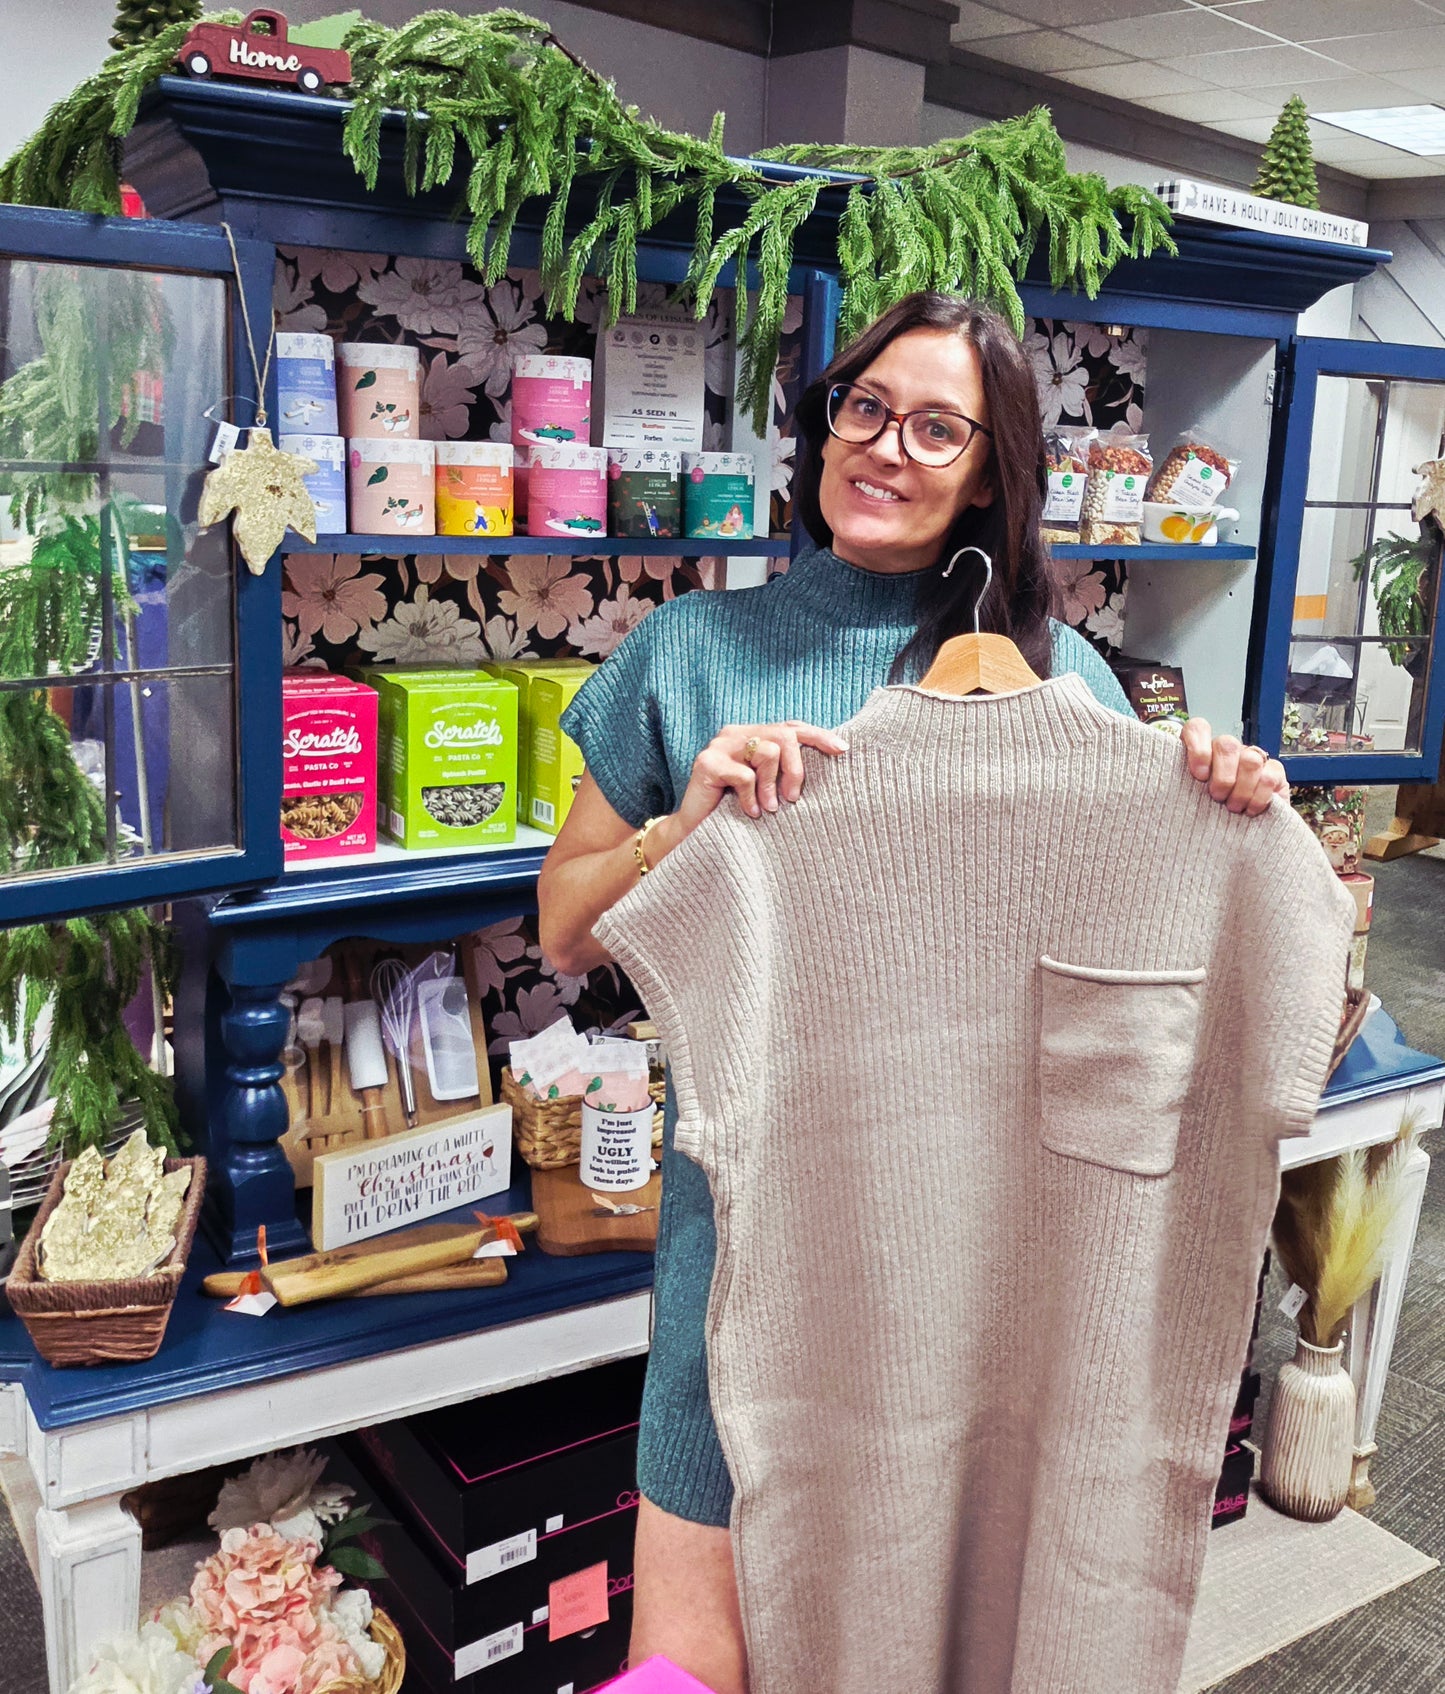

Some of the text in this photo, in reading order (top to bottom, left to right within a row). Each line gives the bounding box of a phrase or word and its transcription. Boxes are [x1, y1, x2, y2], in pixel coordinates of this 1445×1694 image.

[230, 38, 302, 71] Home
[1202, 194, 1349, 240] HAVE A HOLLY JOLLY CHRISTMAS
[1147, 703, 1174, 712] DIP MIX
[283, 725, 362, 758] Scratch
[424, 718, 503, 748] Scratch
[304, 762, 339, 771] PASTA Co
[597, 1126, 636, 1135] impressed
[602, 1136, 611, 1144] by
[348, 1128, 485, 1180] I'M DREAMING OF A WHITE
[598, 1146, 634, 1157] UGLY
[358, 1152, 478, 1197] Christmas
[589, 1164, 604, 1173] look
[617, 1167, 640, 1175] public
[344, 1160, 484, 1216] BUT IF THE WHITE RUNS OUT
[348, 1174, 481, 1233] I'LL DRINK THE RED
